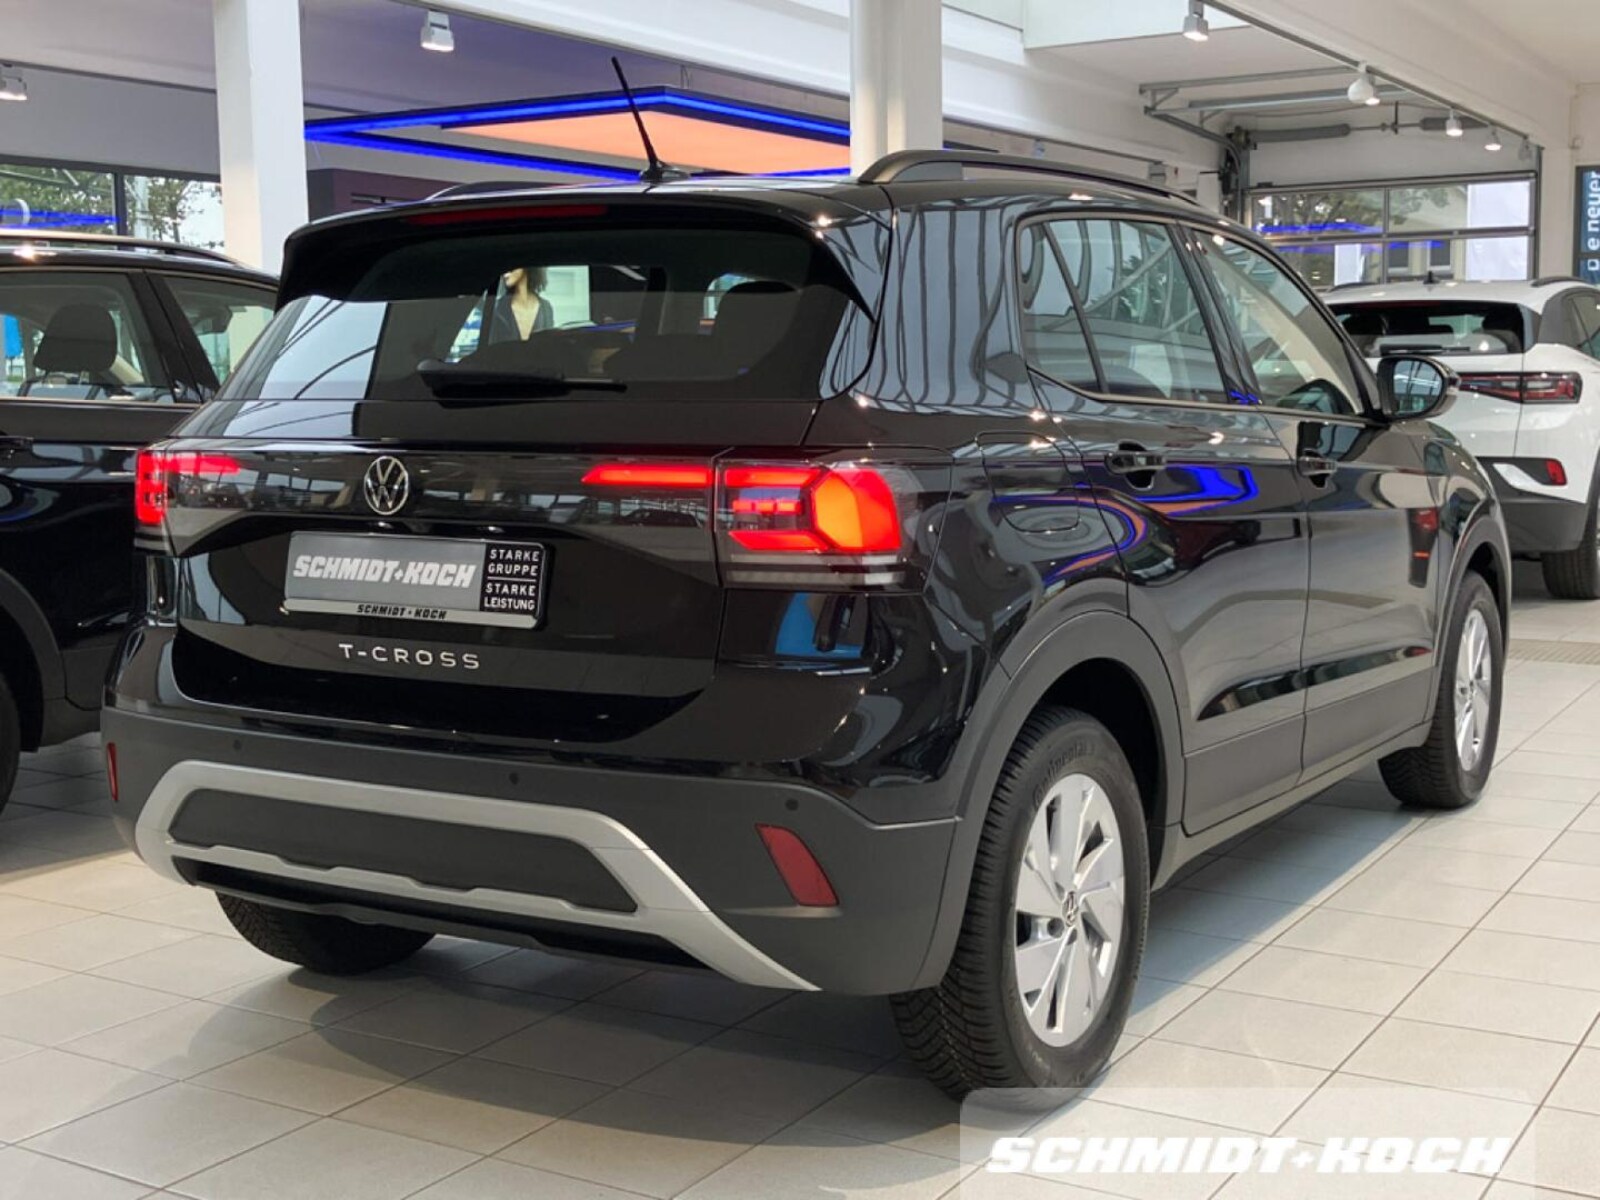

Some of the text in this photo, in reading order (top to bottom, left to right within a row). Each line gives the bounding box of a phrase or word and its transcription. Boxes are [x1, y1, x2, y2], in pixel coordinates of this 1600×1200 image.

[490, 549, 540, 562] STARKE
[488, 562, 539, 577] GRUPPE
[485, 582, 536, 597] STARKE
[483, 596, 536, 611] LEISTUNG
[338, 643, 480, 670] T-CROSS
